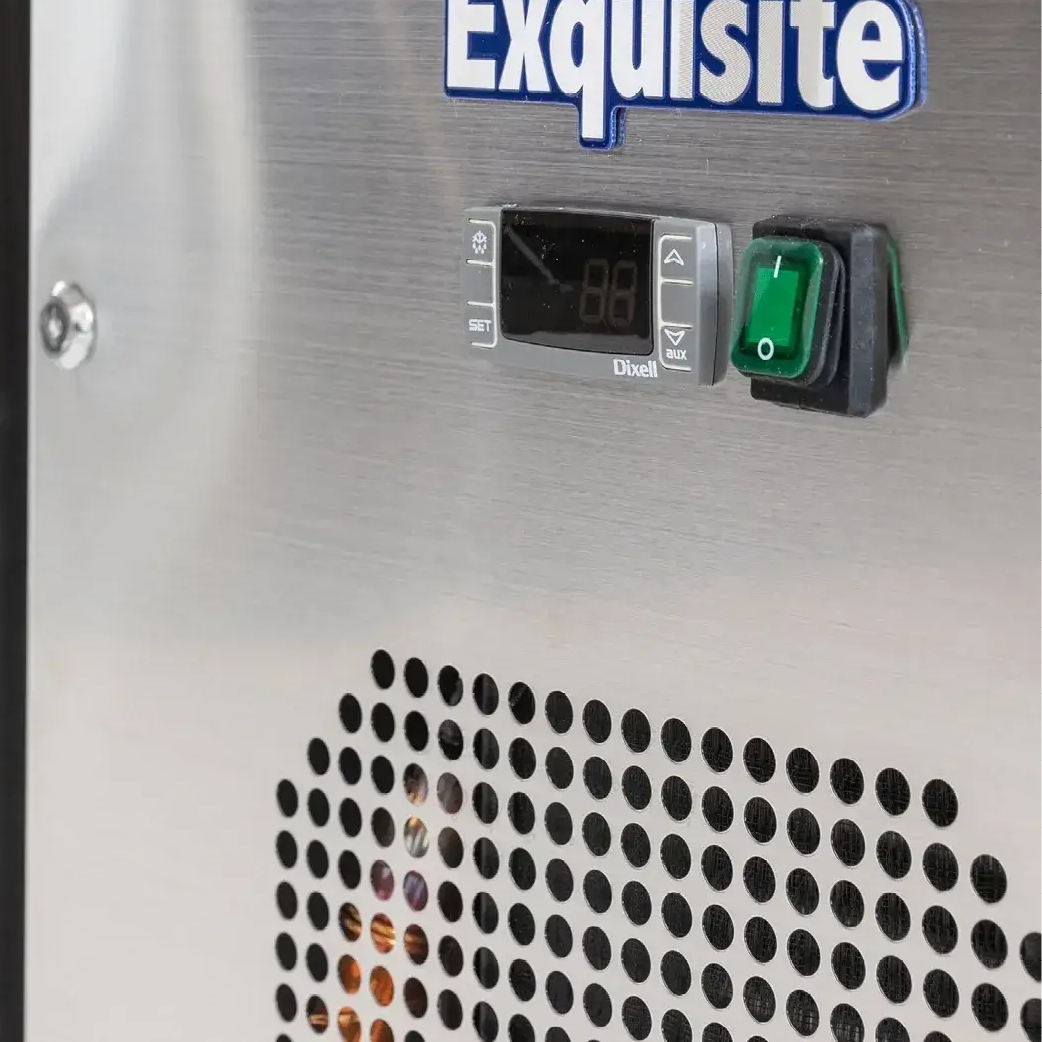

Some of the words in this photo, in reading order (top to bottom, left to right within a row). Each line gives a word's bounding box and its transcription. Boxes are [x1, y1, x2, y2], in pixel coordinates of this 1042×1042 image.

[468, 319, 492, 333] SET
[665, 348, 688, 361] aux
[613, 359, 658, 379] Dixell
